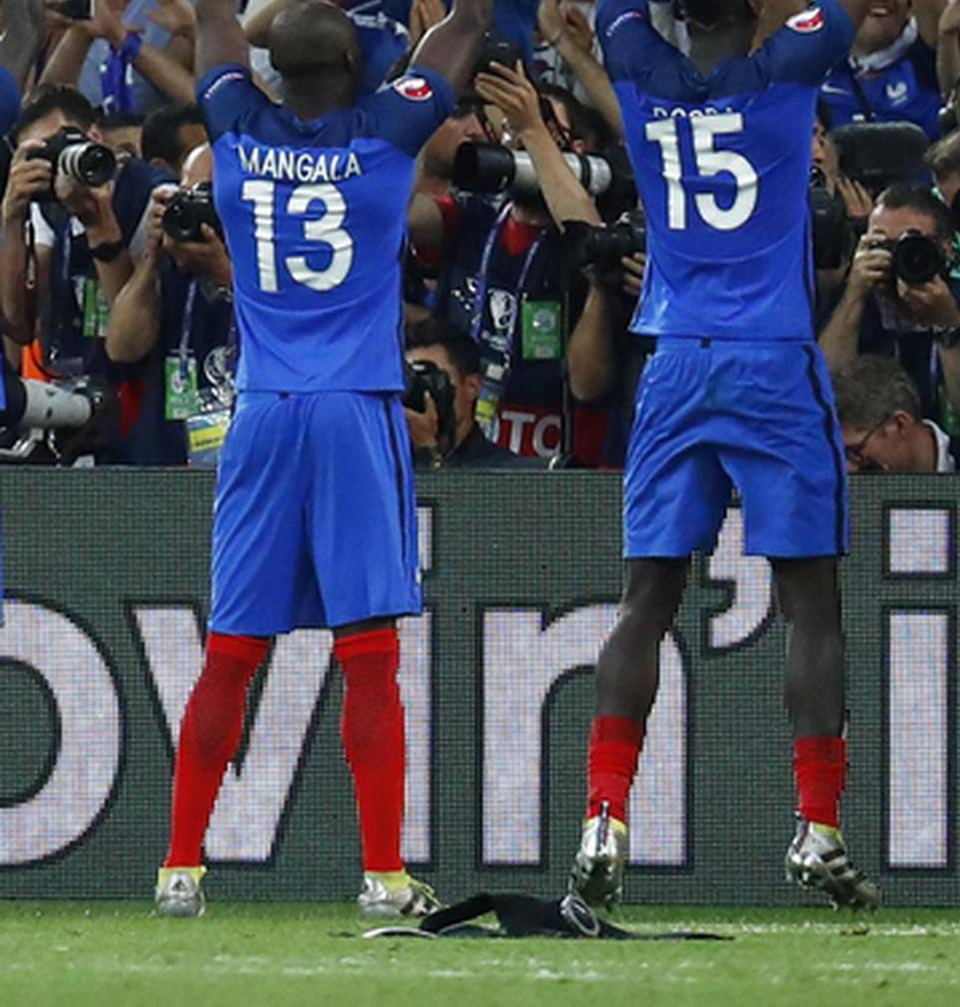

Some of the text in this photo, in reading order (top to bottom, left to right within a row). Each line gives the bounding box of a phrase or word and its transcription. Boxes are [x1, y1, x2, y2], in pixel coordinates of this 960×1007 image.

[238, 144, 362, 182] MANGALA
[645, 112, 758, 231] 15
[242, 180, 354, 293] 13
